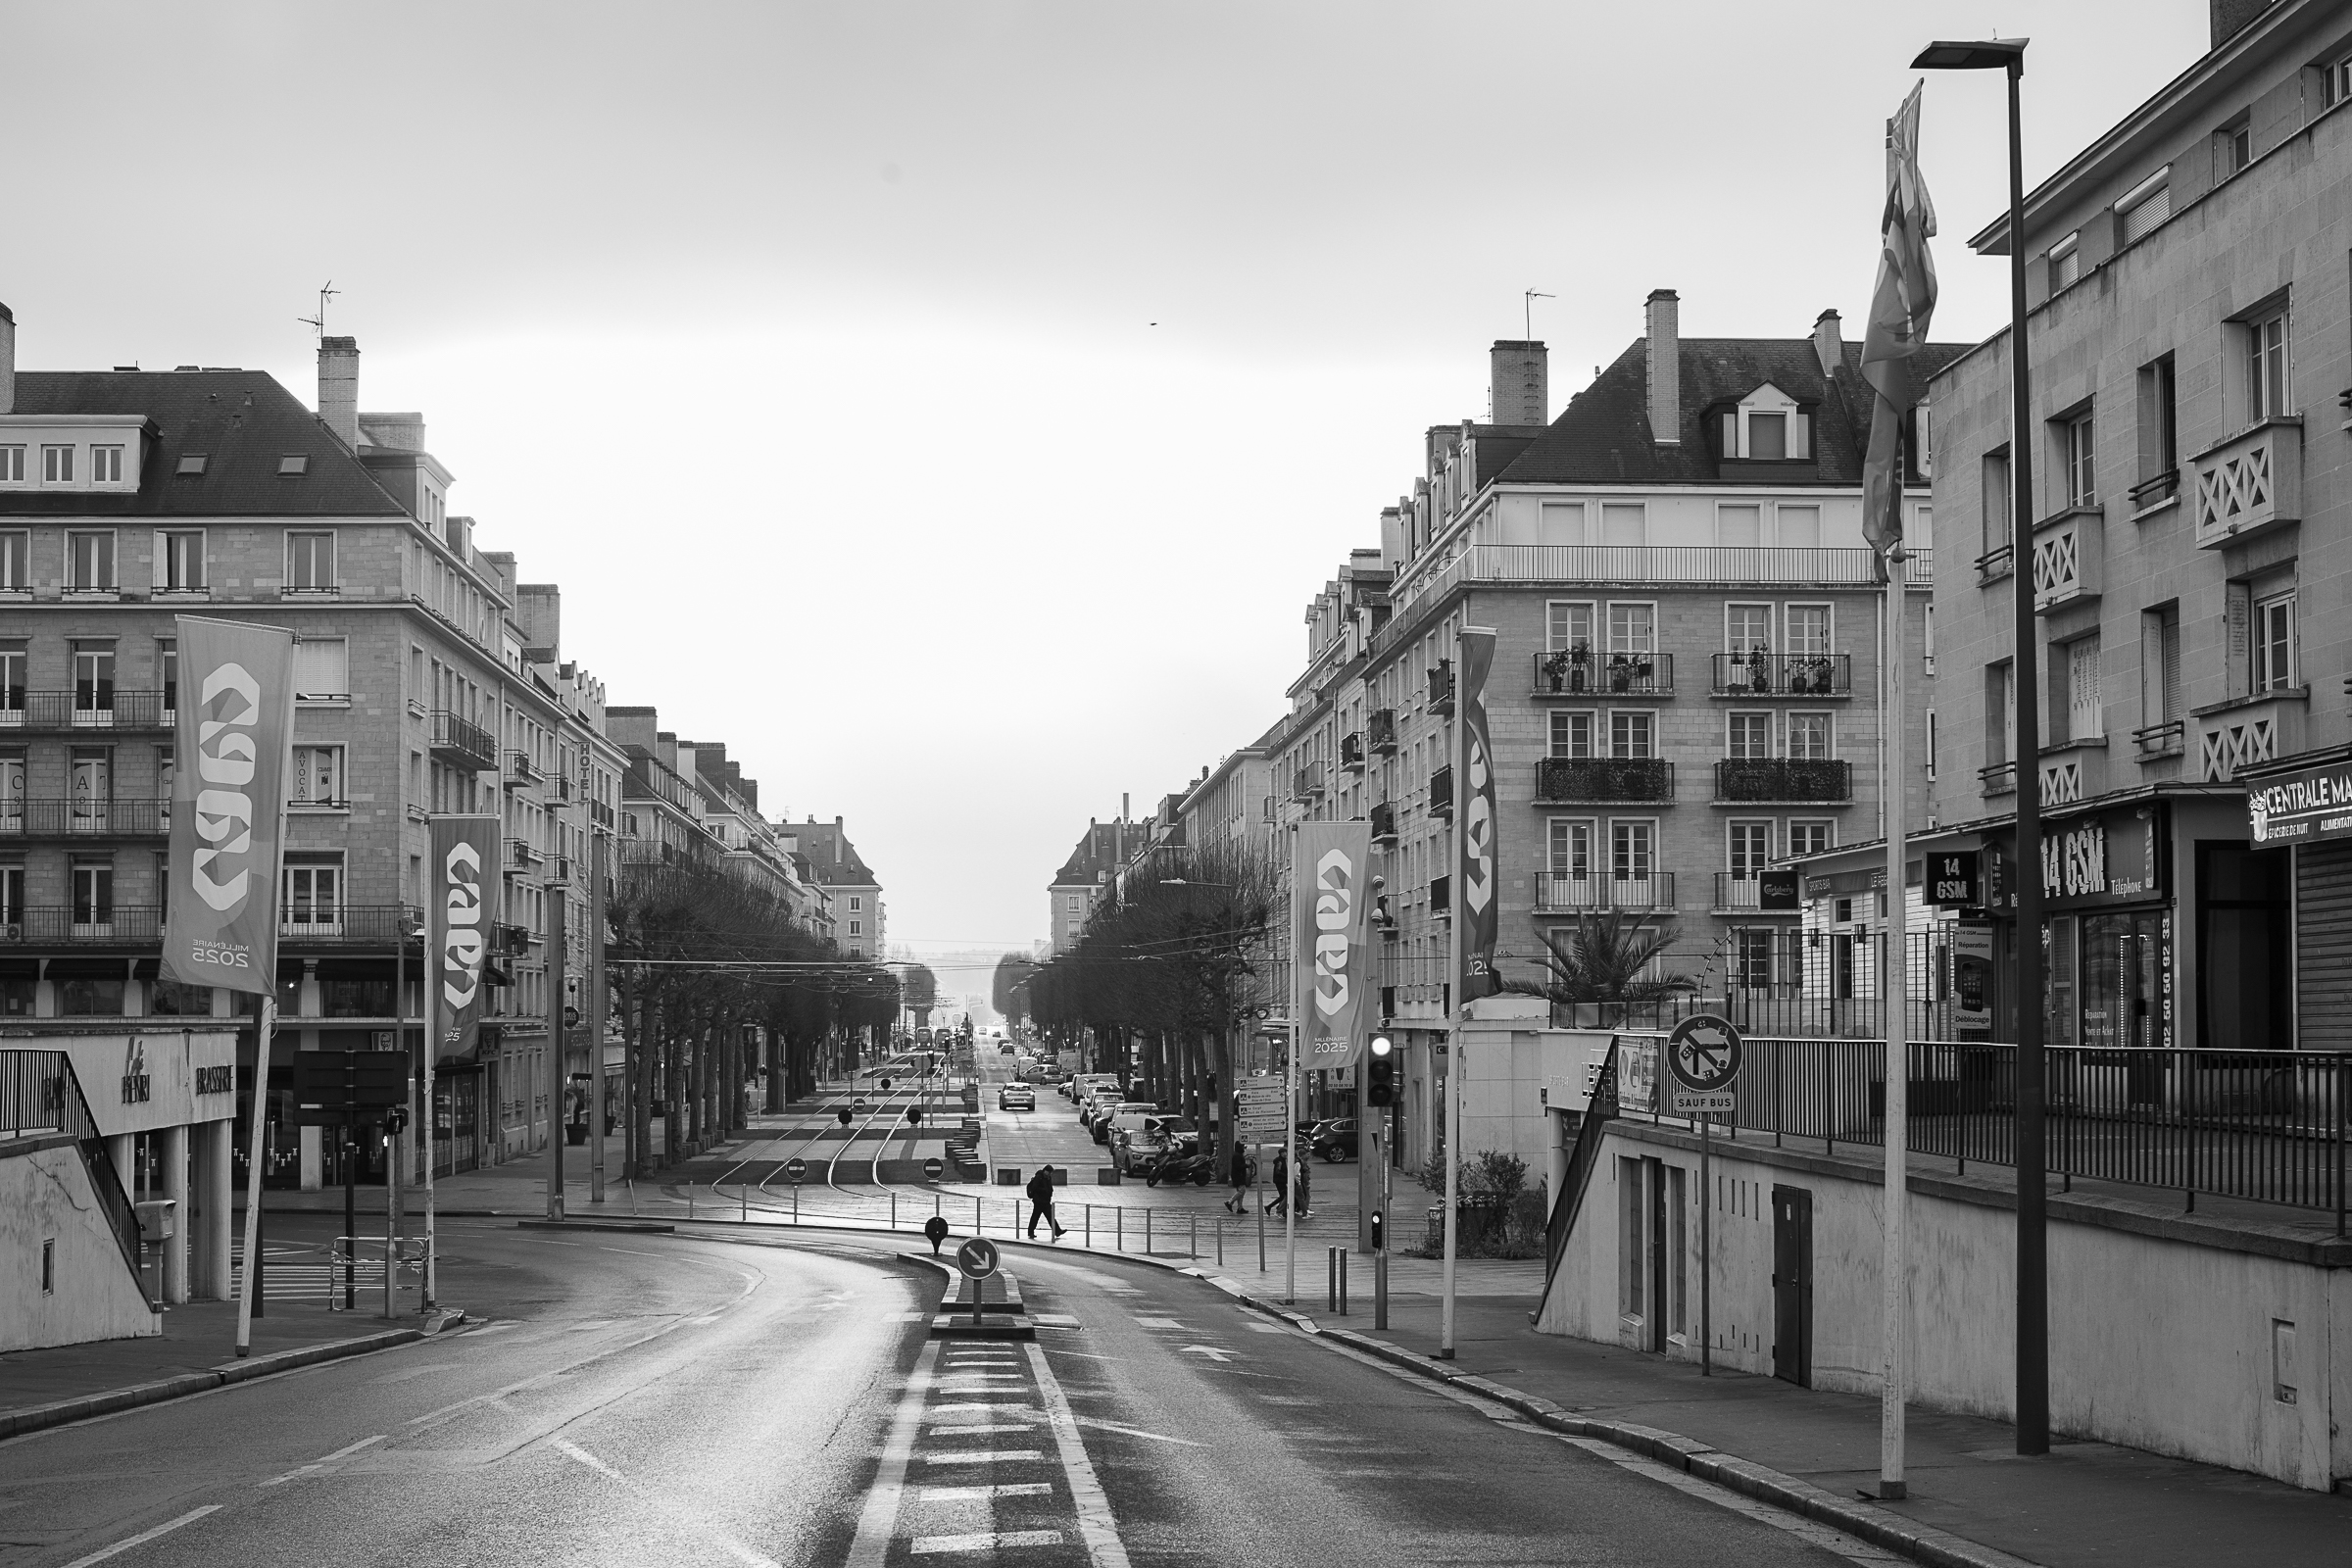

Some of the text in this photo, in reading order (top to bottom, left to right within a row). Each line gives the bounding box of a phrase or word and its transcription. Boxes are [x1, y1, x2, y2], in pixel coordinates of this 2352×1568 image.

[580, 744, 590, 801] HOTEL
[2267, 774, 2352, 814] CENTRALE MA
[2268, 815, 2352, 840] EPICERIE DE NUIT ALIMENTATI
[1943, 858, 1961, 876] 14
[2040, 835, 2061, 899] 14
[2065, 826, 2105, 897] GSM
[1763, 883, 1794, 896] Carlsberg
[1808, 878, 1831, 892] SPORTS BAR
[1936, 880, 1968, 899] GSM
[2162, 917, 2170, 939] 33
[1955, 1015, 1989, 1024] Déblocage
[1314, 1042, 1348, 1053] 2025
[122, 1074, 151, 1104] HENRI
[195, 1064, 234, 1096] BRASSERIE
[1678, 1098, 1732, 1107] SAUF BUS
